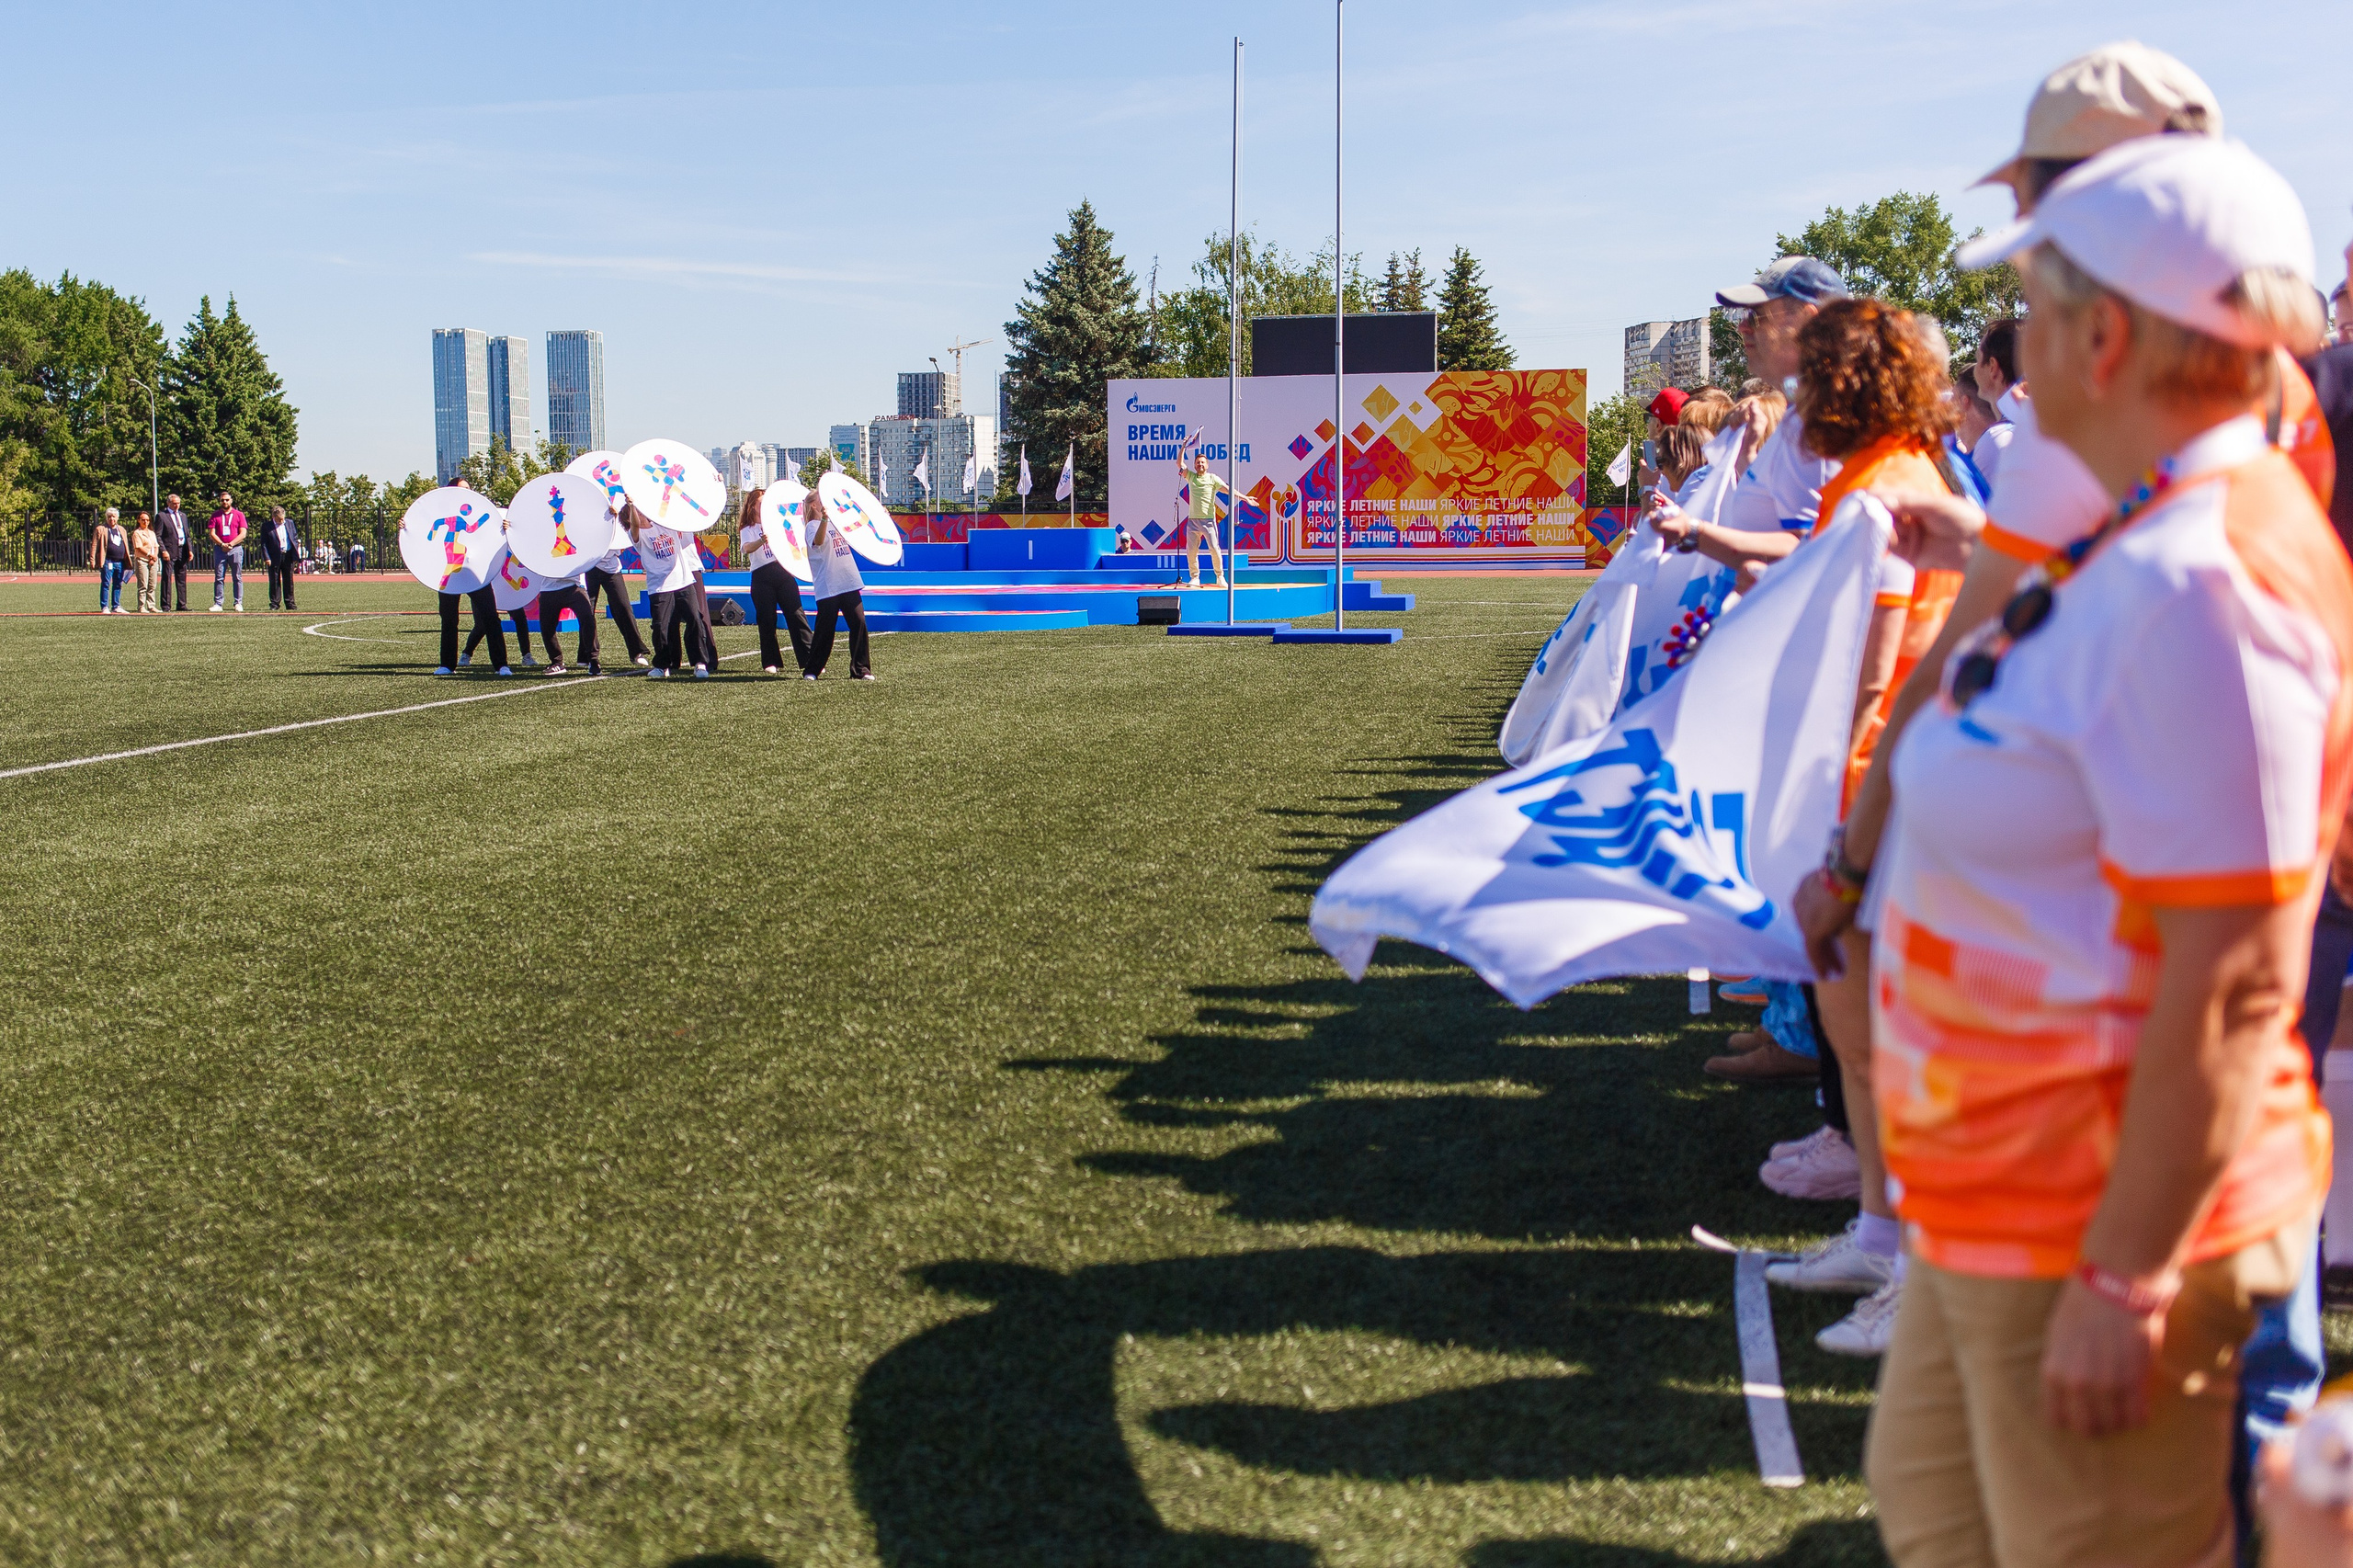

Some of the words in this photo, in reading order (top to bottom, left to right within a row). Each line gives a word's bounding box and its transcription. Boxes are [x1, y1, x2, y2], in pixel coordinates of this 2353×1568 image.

[1139, 404, 1176, 413] МОСЭНЕРГО
[1128, 425, 1186, 441] ВРЕМЯ
[1195, 443, 1251, 462] ПОБД
[1349, 499, 1396, 511] ЛЕТНИЕ
[1400, 498, 1437, 511] НАШИ
[1440, 498, 1481, 511] ЯРКИЕ
[1483, 497, 1533, 510] ЛЕТНИЕ
[1536, 496, 1575, 509] НАШИ
[1349, 515, 1398, 528] ЛЕТНИЕ
[1401, 515, 1439, 528] НАШИ
[1442, 514, 1483, 527] ЯРКИЕ
[1486, 514, 1534, 527] ЛЕТНИЕ
[1538, 512, 1575, 526] НАШИ
[1349, 531, 1396, 543] ЛЕТНИЕ
[1400, 530, 1437, 543] НАШИ
[1439, 530, 1480, 542] ЯРКИЕ
[1483, 529, 1532, 542] ЛЕТНИЕ
[1536, 528, 1575, 541] НАШИ
